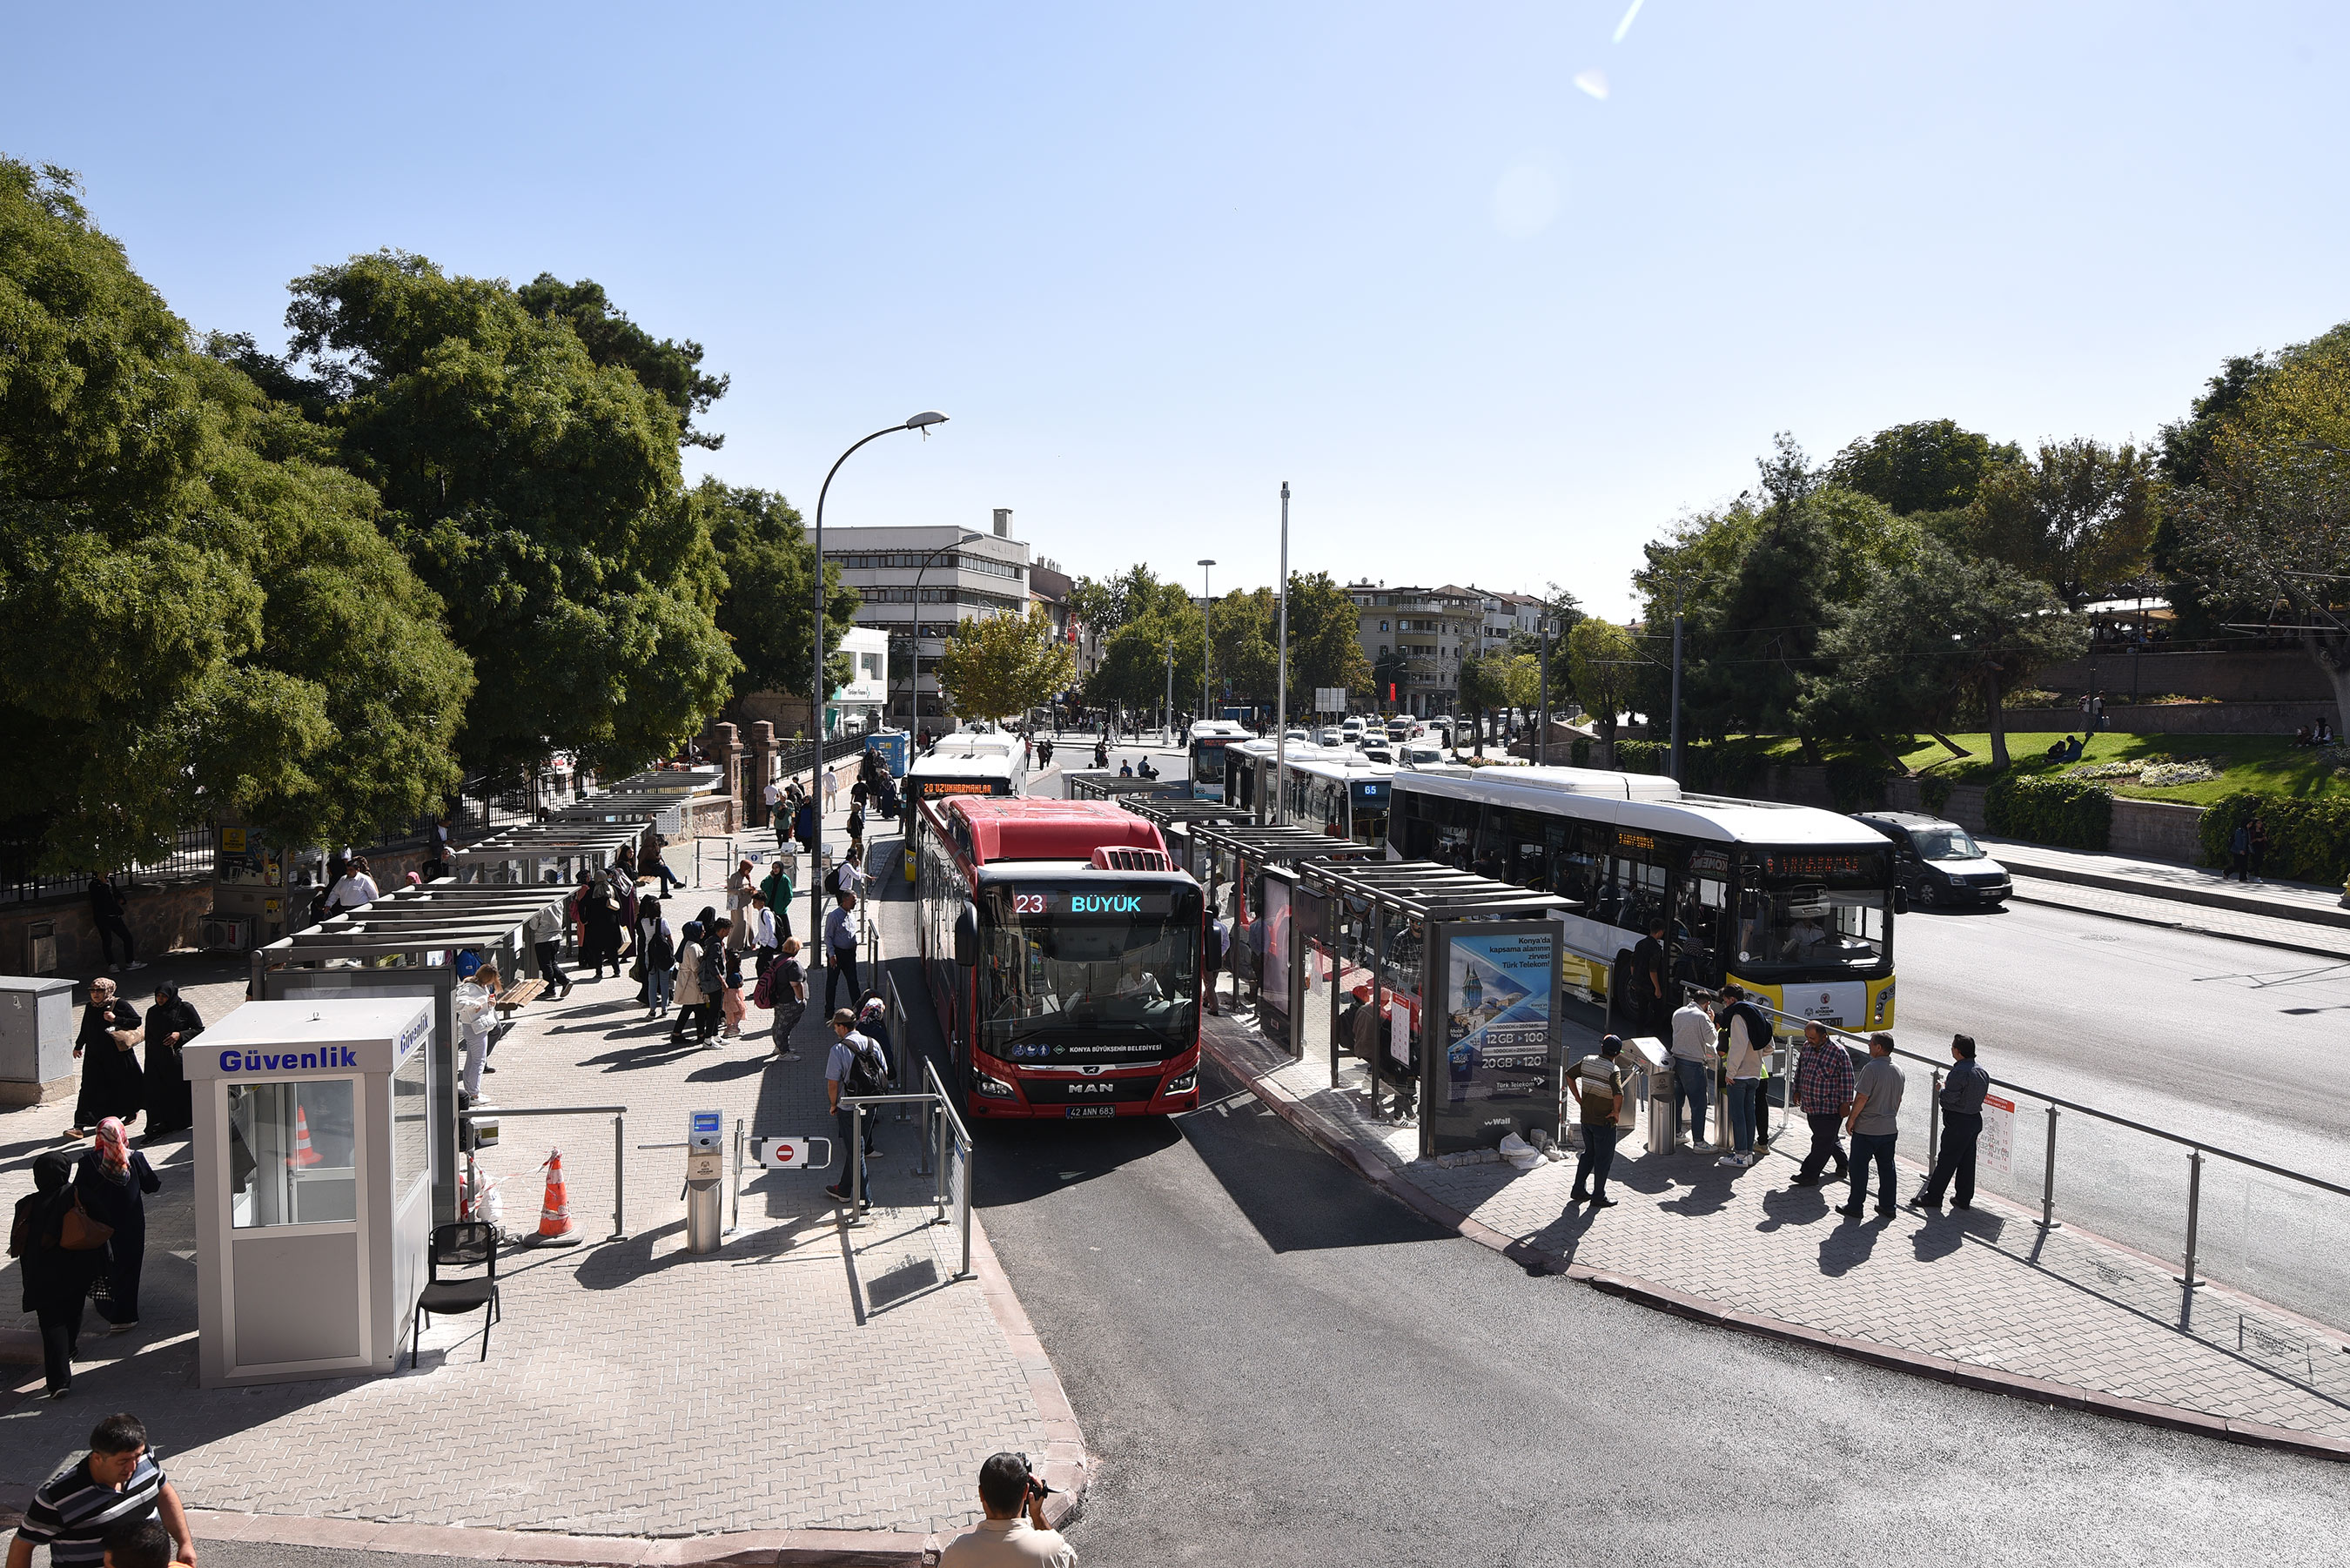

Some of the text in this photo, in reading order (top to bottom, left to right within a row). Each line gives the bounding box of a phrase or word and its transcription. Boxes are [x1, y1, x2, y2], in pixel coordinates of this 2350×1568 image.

[923, 783, 934, 793] 20
[1365, 785, 1376, 794] 65
[1015, 894, 1142, 914] 23 BÜYÜK
[1518, 936, 1551, 945] Konya'da
[1489, 946, 1521, 955] kapsama
[400, 1012, 429, 1055] Güvenlik
[1524, 1032, 1544, 1042] 100
[1092, 1044, 1127, 1054] BÜYÜKŞEHİR
[1127, 1043, 1162, 1052] BELEDİYESİ
[219, 1046, 357, 1072] Güvenlik
[1523, 1055, 1542, 1067] 120
[1068, 1083, 1114, 1094] MAN
[1071, 1107, 1114, 1116] 42 ANN 683
[1493, 1117, 1511, 1126] Wall
